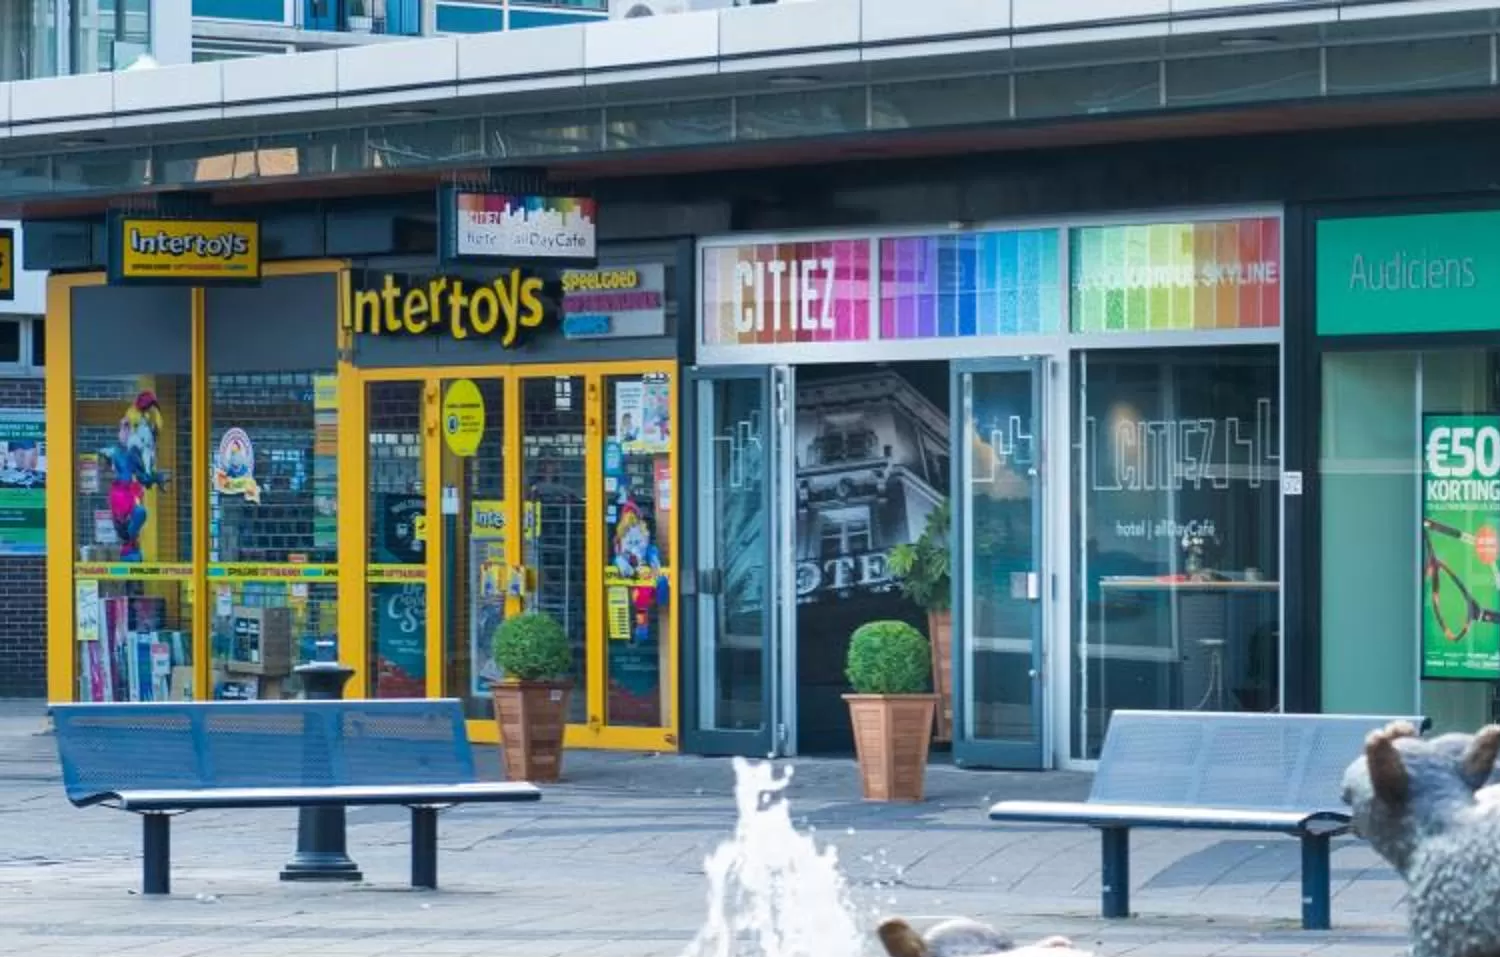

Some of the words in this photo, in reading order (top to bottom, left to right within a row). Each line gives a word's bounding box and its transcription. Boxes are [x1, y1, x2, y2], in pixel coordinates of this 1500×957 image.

[130, 227, 249, 260] Intertoys
[1350, 248, 1476, 292] Audiciens
[339, 267, 545, 348] Intertoys
[734, 257, 836, 334] CITIEZ
[1115, 419, 1217, 492] CITIEZ
[1426, 479, 1500, 502] KORTING
[797, 553, 893, 595] OTE
